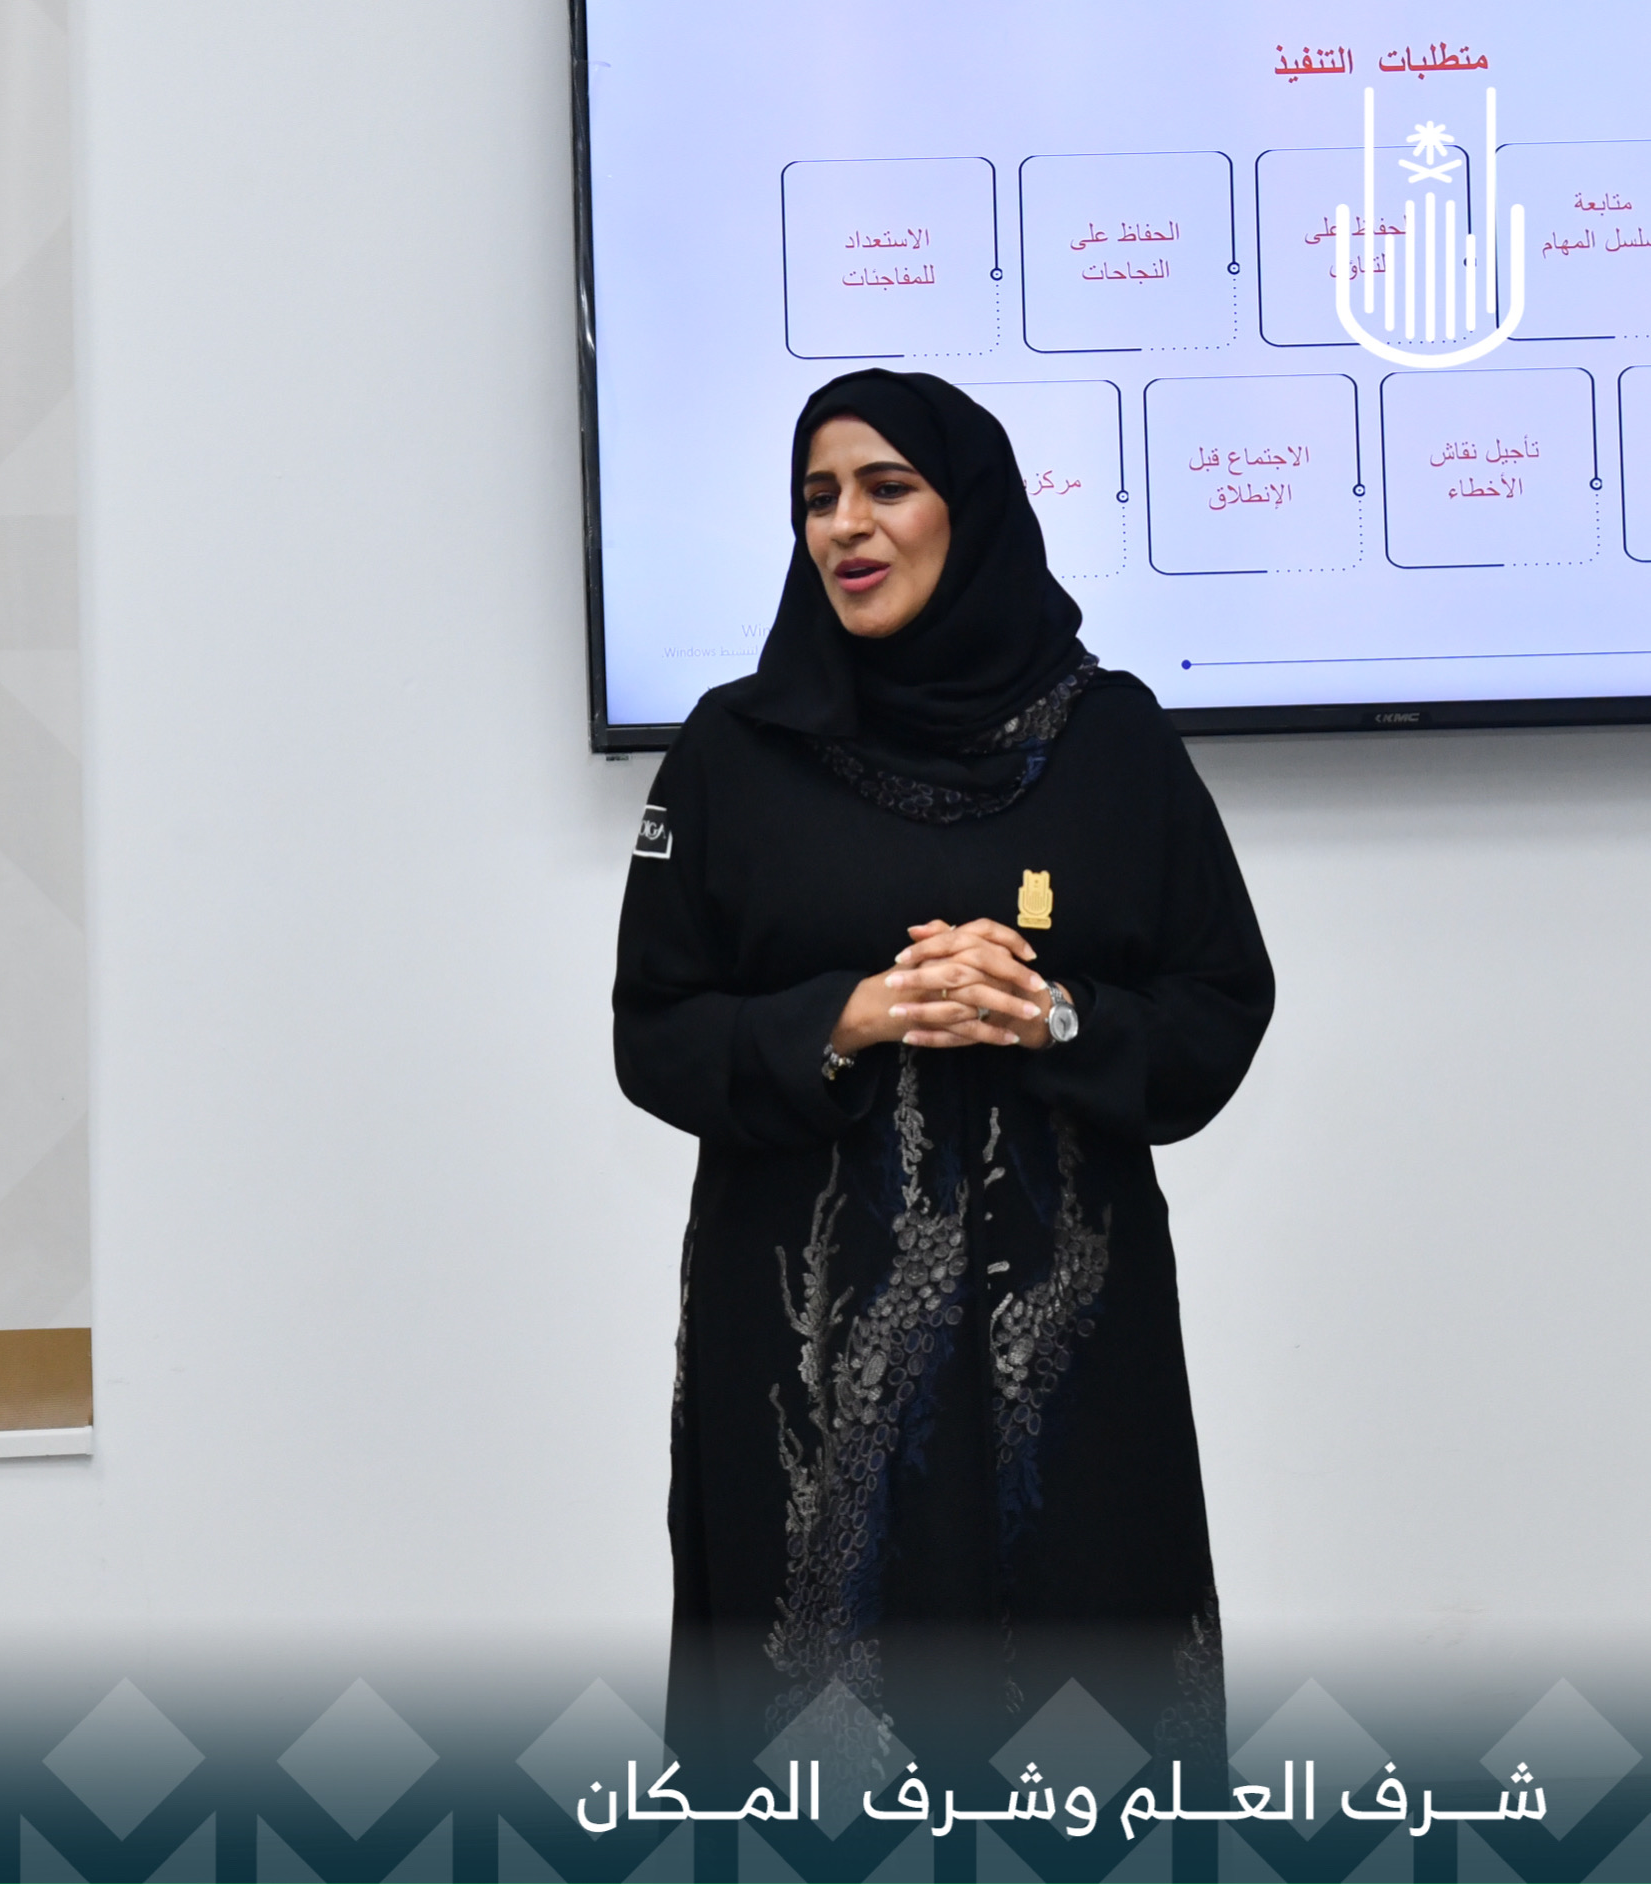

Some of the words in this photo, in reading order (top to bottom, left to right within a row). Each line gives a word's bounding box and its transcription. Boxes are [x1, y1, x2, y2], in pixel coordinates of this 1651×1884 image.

[1274, 45, 1354, 83] التنفيذ
[1378, 41, 1489, 80] متطلبات
[1574, 192, 1633, 216] متابعة
[845, 228, 929, 249] الاستعداد
[1070, 222, 1108, 250] على
[1117, 220, 1180, 242] الحفاظ
[1542, 229, 1595, 260] المهام
[842, 264, 935, 291] للمفاجئات
[1081, 259, 1170, 285] النجاحات
[1189, 446, 1220, 472] قبل
[1227, 446, 1309, 475] الاجتماع
[1429, 441, 1477, 467] نقاش
[1485, 434, 1540, 465] تأجيل
[1208, 483, 1292, 510] الإنطلاق
[1448, 472, 1523, 499] الأخطاء
